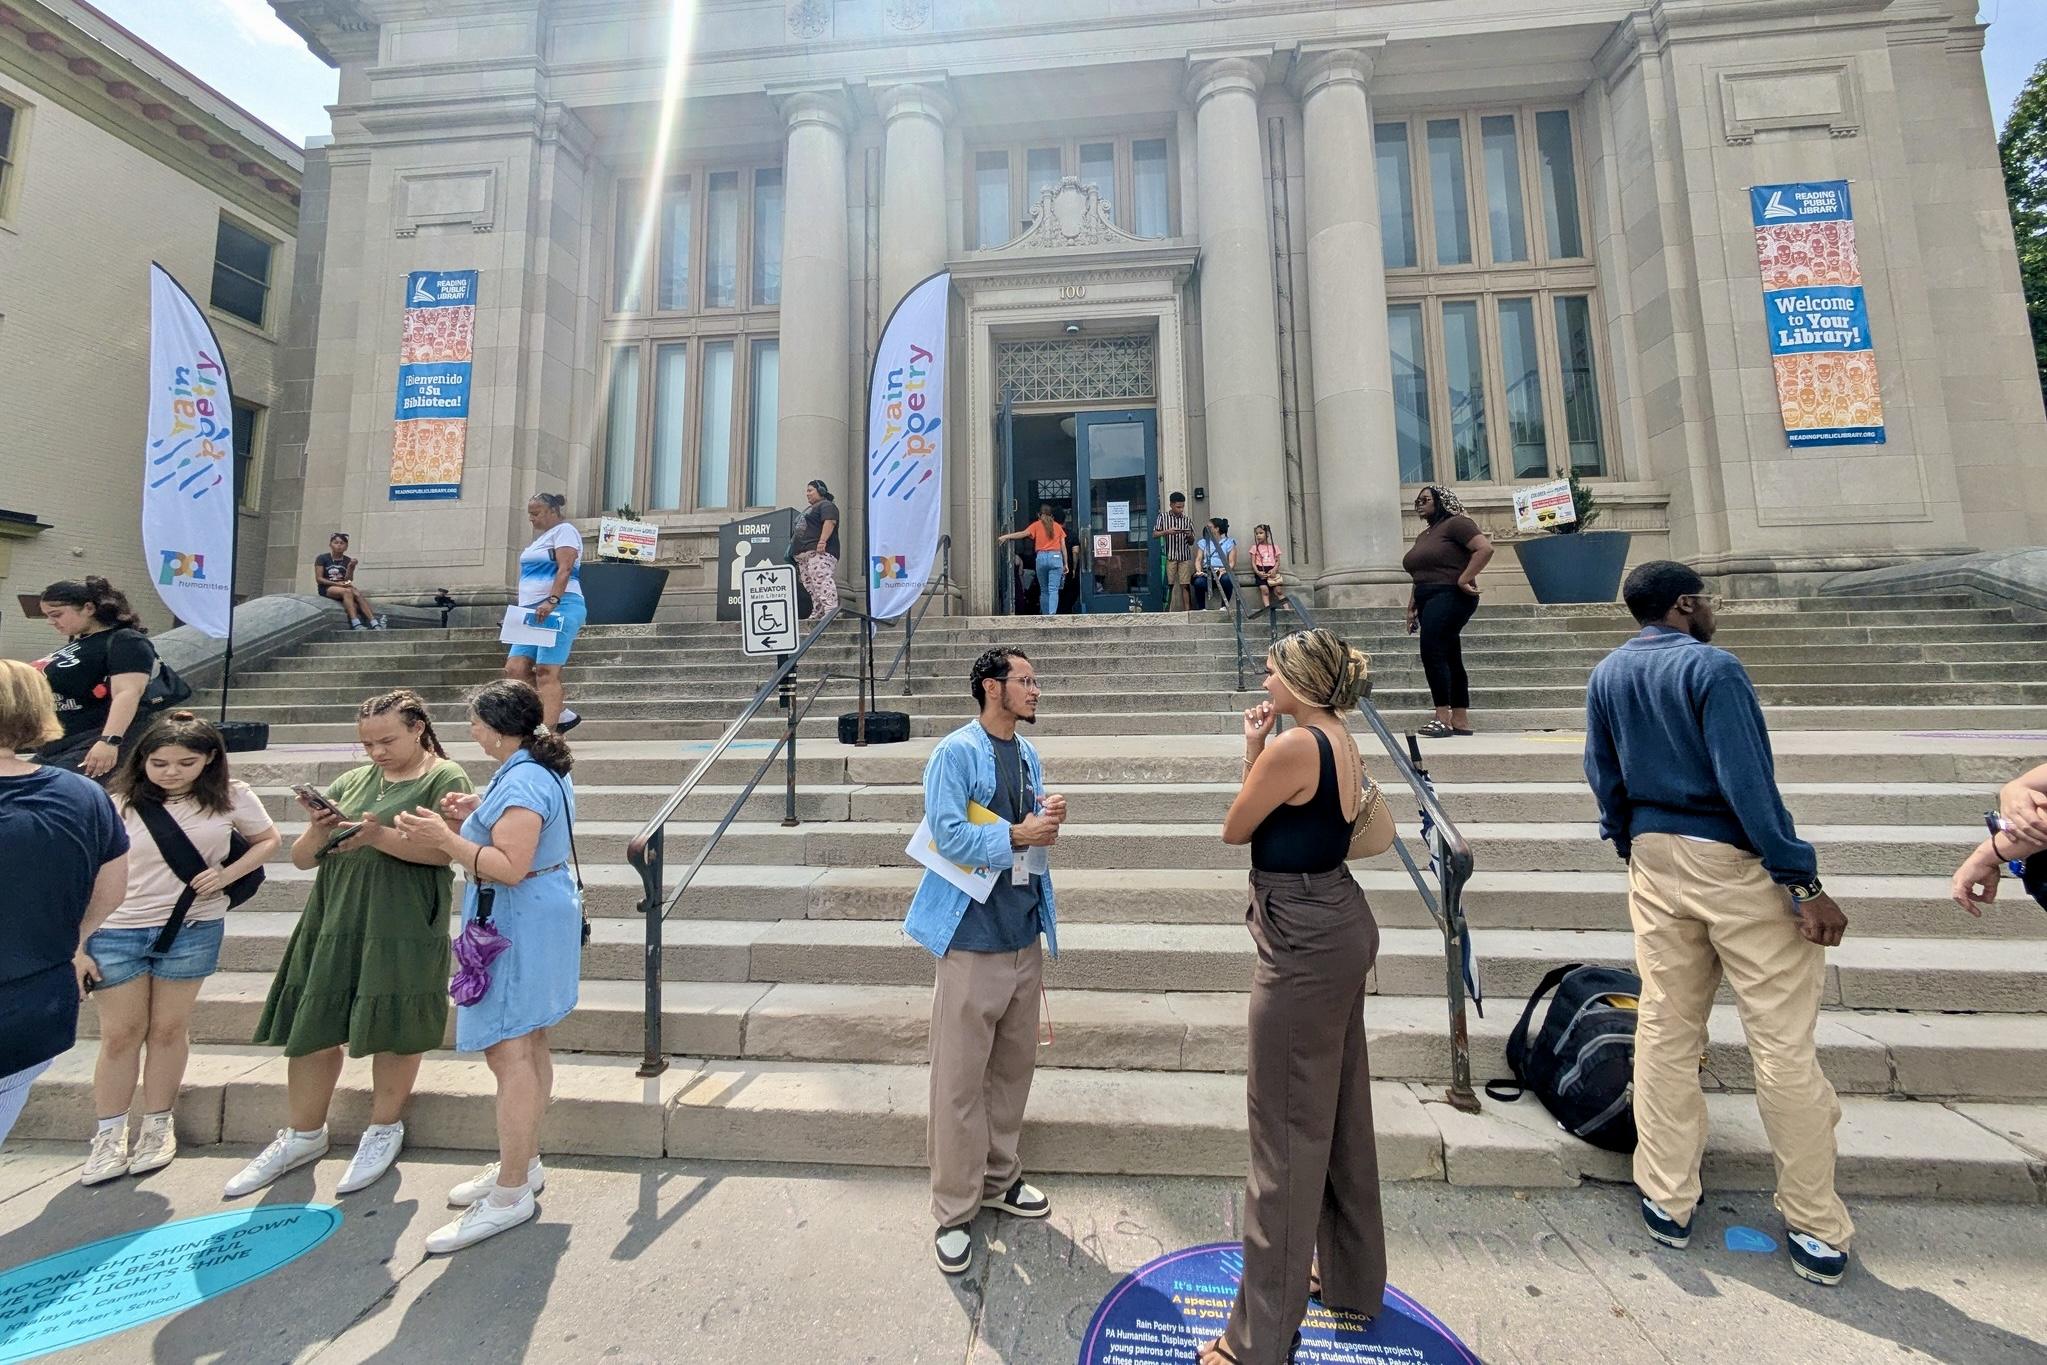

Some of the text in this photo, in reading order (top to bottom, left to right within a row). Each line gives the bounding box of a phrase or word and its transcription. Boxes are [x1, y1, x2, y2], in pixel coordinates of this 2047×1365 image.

[1795, 191, 1836, 200] READING
[1803, 198, 1837, 207] PUBLIC
[1799, 205, 1838, 215] LIBRARY
[437, 279, 467, 287] READING
[437, 292, 465, 300] LIBRARY
[1061, 286, 1085, 299] 100
[1774, 295, 1855, 314] Welcome
[1788, 313, 1850, 329] to Your
[1778, 326, 1861, 348] Library!
[405, 373, 463, 387] ¡Bienvenido
[425, 385, 441, 396] Su
[169, 365, 196, 438] rain
[192, 350, 226, 462] poetry
[403, 395, 462, 409] Biblioteca!
[880, 367, 904, 446] rain
[904, 343, 936, 458] poetry
[1789, 431, 1876, 441] READINGPUBLICLIBRARY.ORG
[738, 523, 771, 535] LIBRARY
[178, 579, 230, 592] humanities
[750, 585, 787, 594] ELEVATOR
[147, 1234, 228, 1260] SHINES
[232, 1215, 302, 1239] DOWN
[32, 1276, 95, 1301] CITY
[94, 1270, 120, 1285] IS
[123, 1240, 246, 1277] BEAUTIFUL
[91, 1267, 180, 1297] LIGHTS
[183, 1248, 253, 1273] SHINE
[1173, 1280, 1193, 1292] It's
[1172, 1294, 1182, 1304] A
[1184, 1296, 1227, 1309] special
[66, 1308, 122, 1329] Peter's
[127, 1291, 182, 1313] School
[1183, 1307, 1197, 1316] as
[1199, 1309, 1224, 1319] you
[1136, 1317, 1153, 1330] Rain
[1153, 1320, 1177, 1334] Poetry
[1178, 1323, 1185, 1333] is
[1185, 1326, 1191, 1334] a
[1333, 1341, 1384, 1355] engagement
[1383, 1345, 1413, 1358] project
[1412, 1347, 1424, 1359] by
[1105, 1328, 1116, 1338] PA
[1116, 1329, 1160, 1343] Humanities.
[1161, 1334, 1198, 1348] Displayed
[1309, 1348, 1320, 1361] by
[1320, 1351, 1356, 1364] students
[1355, 1354, 1377, 1365] from
[1110, 1342, 1135, 1355] young
[1135, 1345, 1164, 1356] patrons
[1164, 1347, 1173, 1357] of
[1102, 1354, 1112, 1365] of
[1112, 1355, 1133, 1365] these
